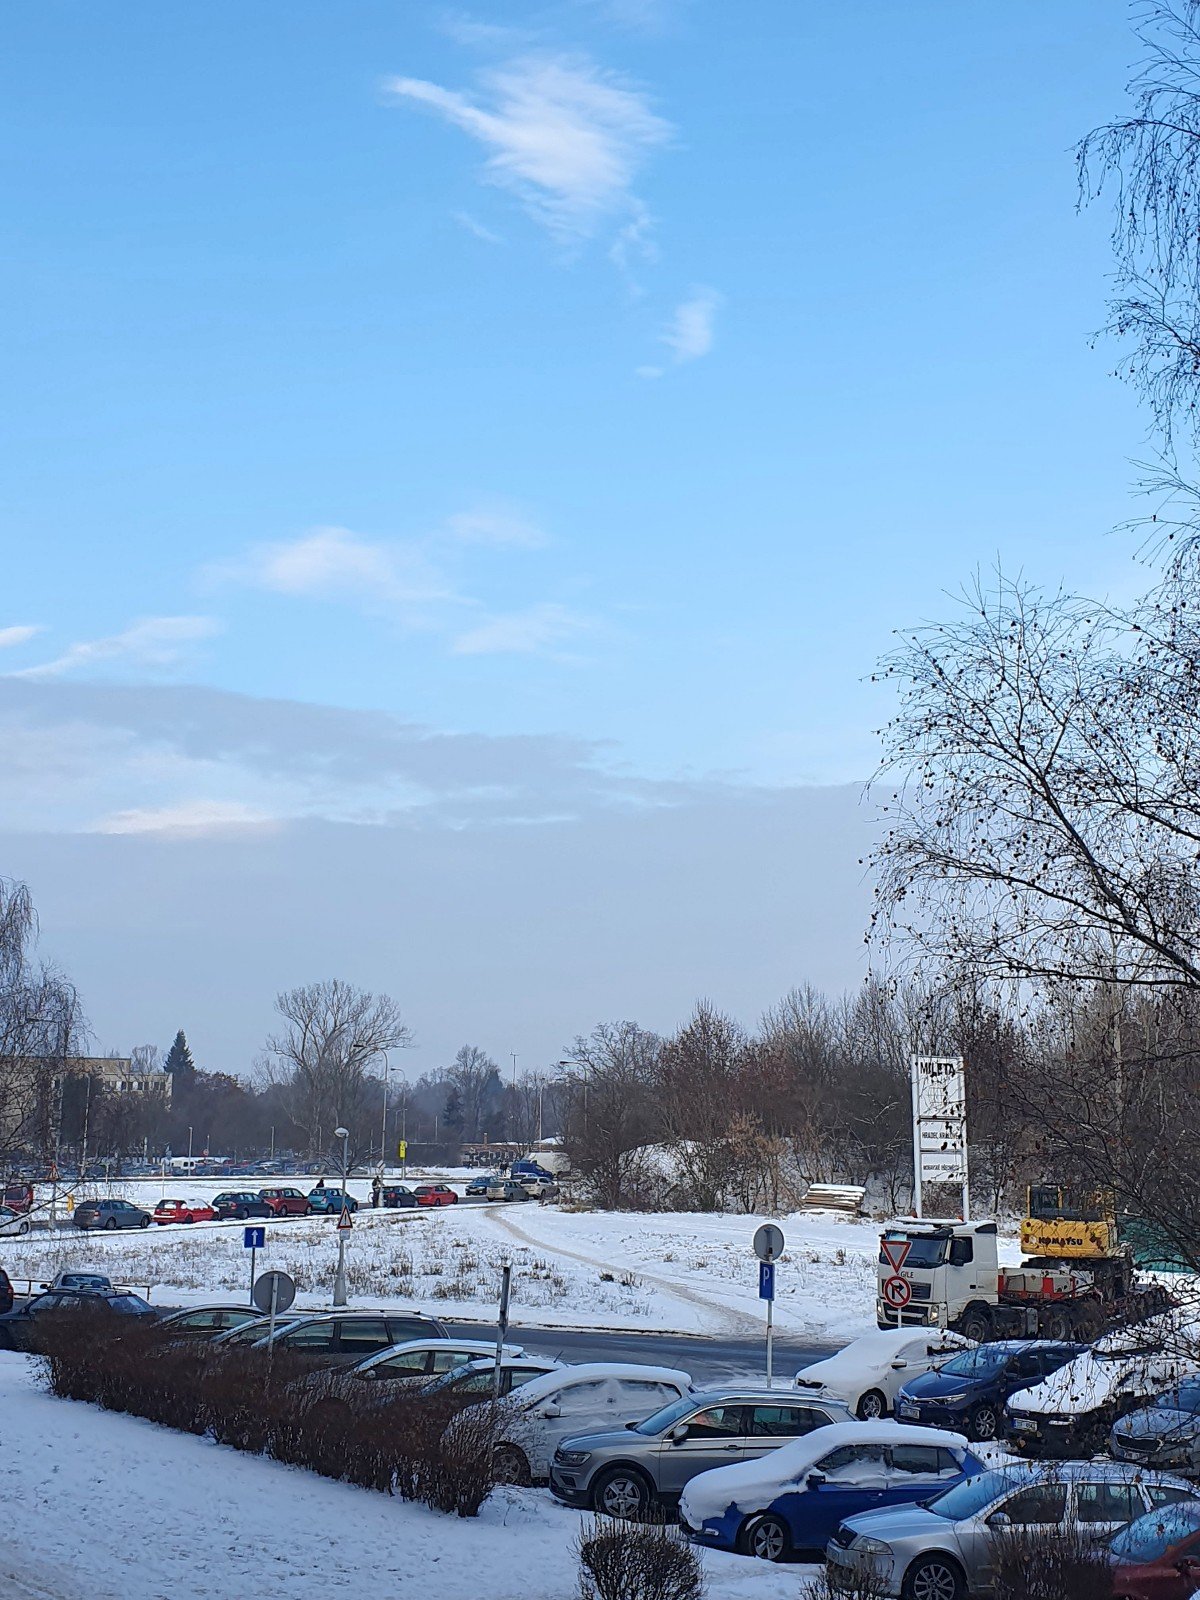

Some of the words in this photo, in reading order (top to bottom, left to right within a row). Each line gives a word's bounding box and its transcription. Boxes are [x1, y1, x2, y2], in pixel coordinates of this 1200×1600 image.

[920, 1062, 955, 1075] MILETA
[1038, 1236, 1083, 1246] KOMATSU
[763, 1266, 770, 1286] P
